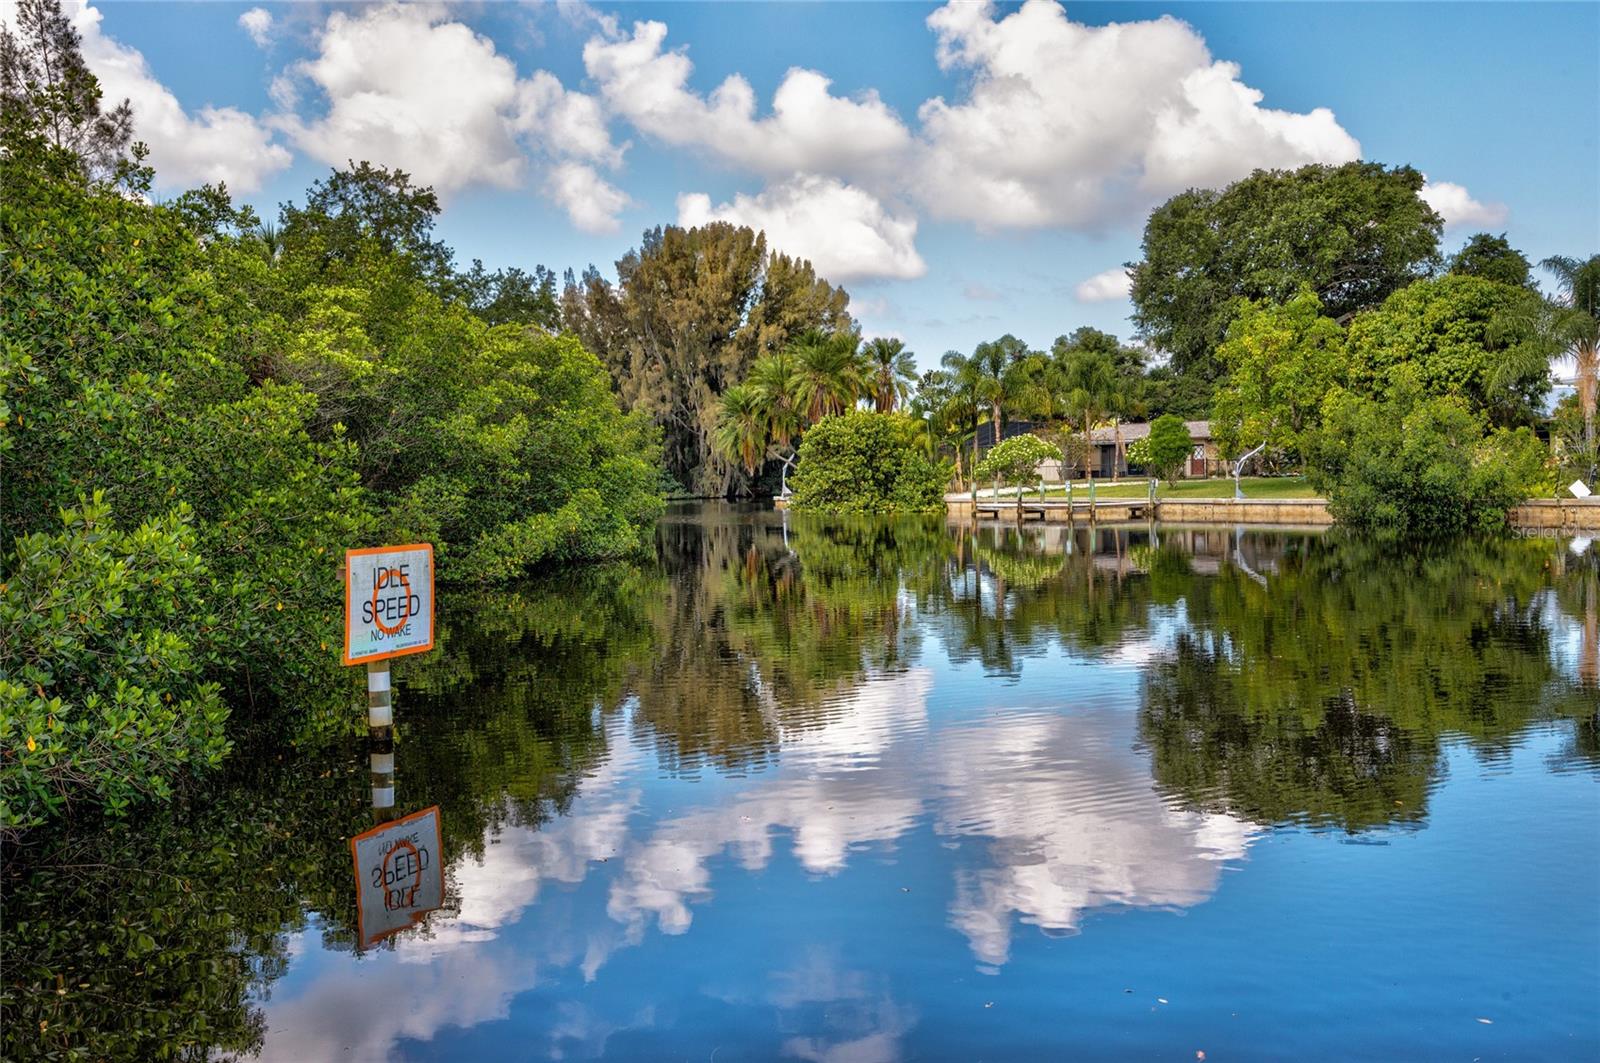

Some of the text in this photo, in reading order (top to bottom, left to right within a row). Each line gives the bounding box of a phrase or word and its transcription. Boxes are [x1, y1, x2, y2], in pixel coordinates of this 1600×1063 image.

[373, 564, 410, 590] IDLE
[362, 594, 420, 624] SPEED
[370, 623, 412, 641] NO WAKE
